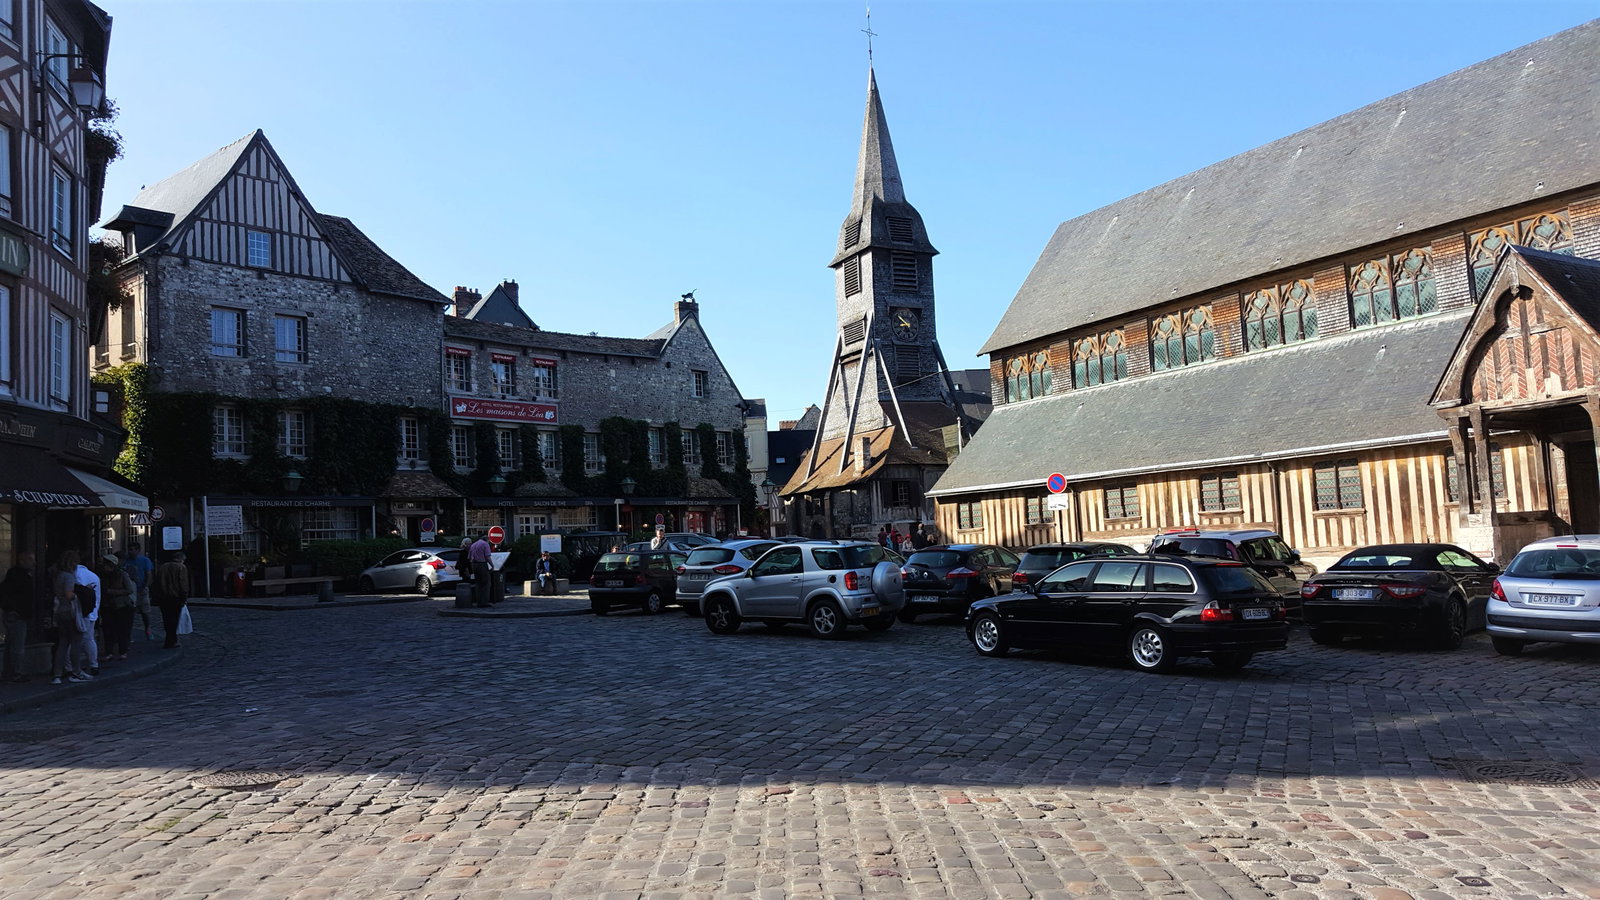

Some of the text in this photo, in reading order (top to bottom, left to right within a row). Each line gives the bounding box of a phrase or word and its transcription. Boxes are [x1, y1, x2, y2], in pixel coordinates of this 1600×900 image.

[468, 401, 544, 418] Les maisons de Léa
[14, 490, 90, 505] SCULPTURES
[1533, 595, 1569, 604] CX-977-BX
